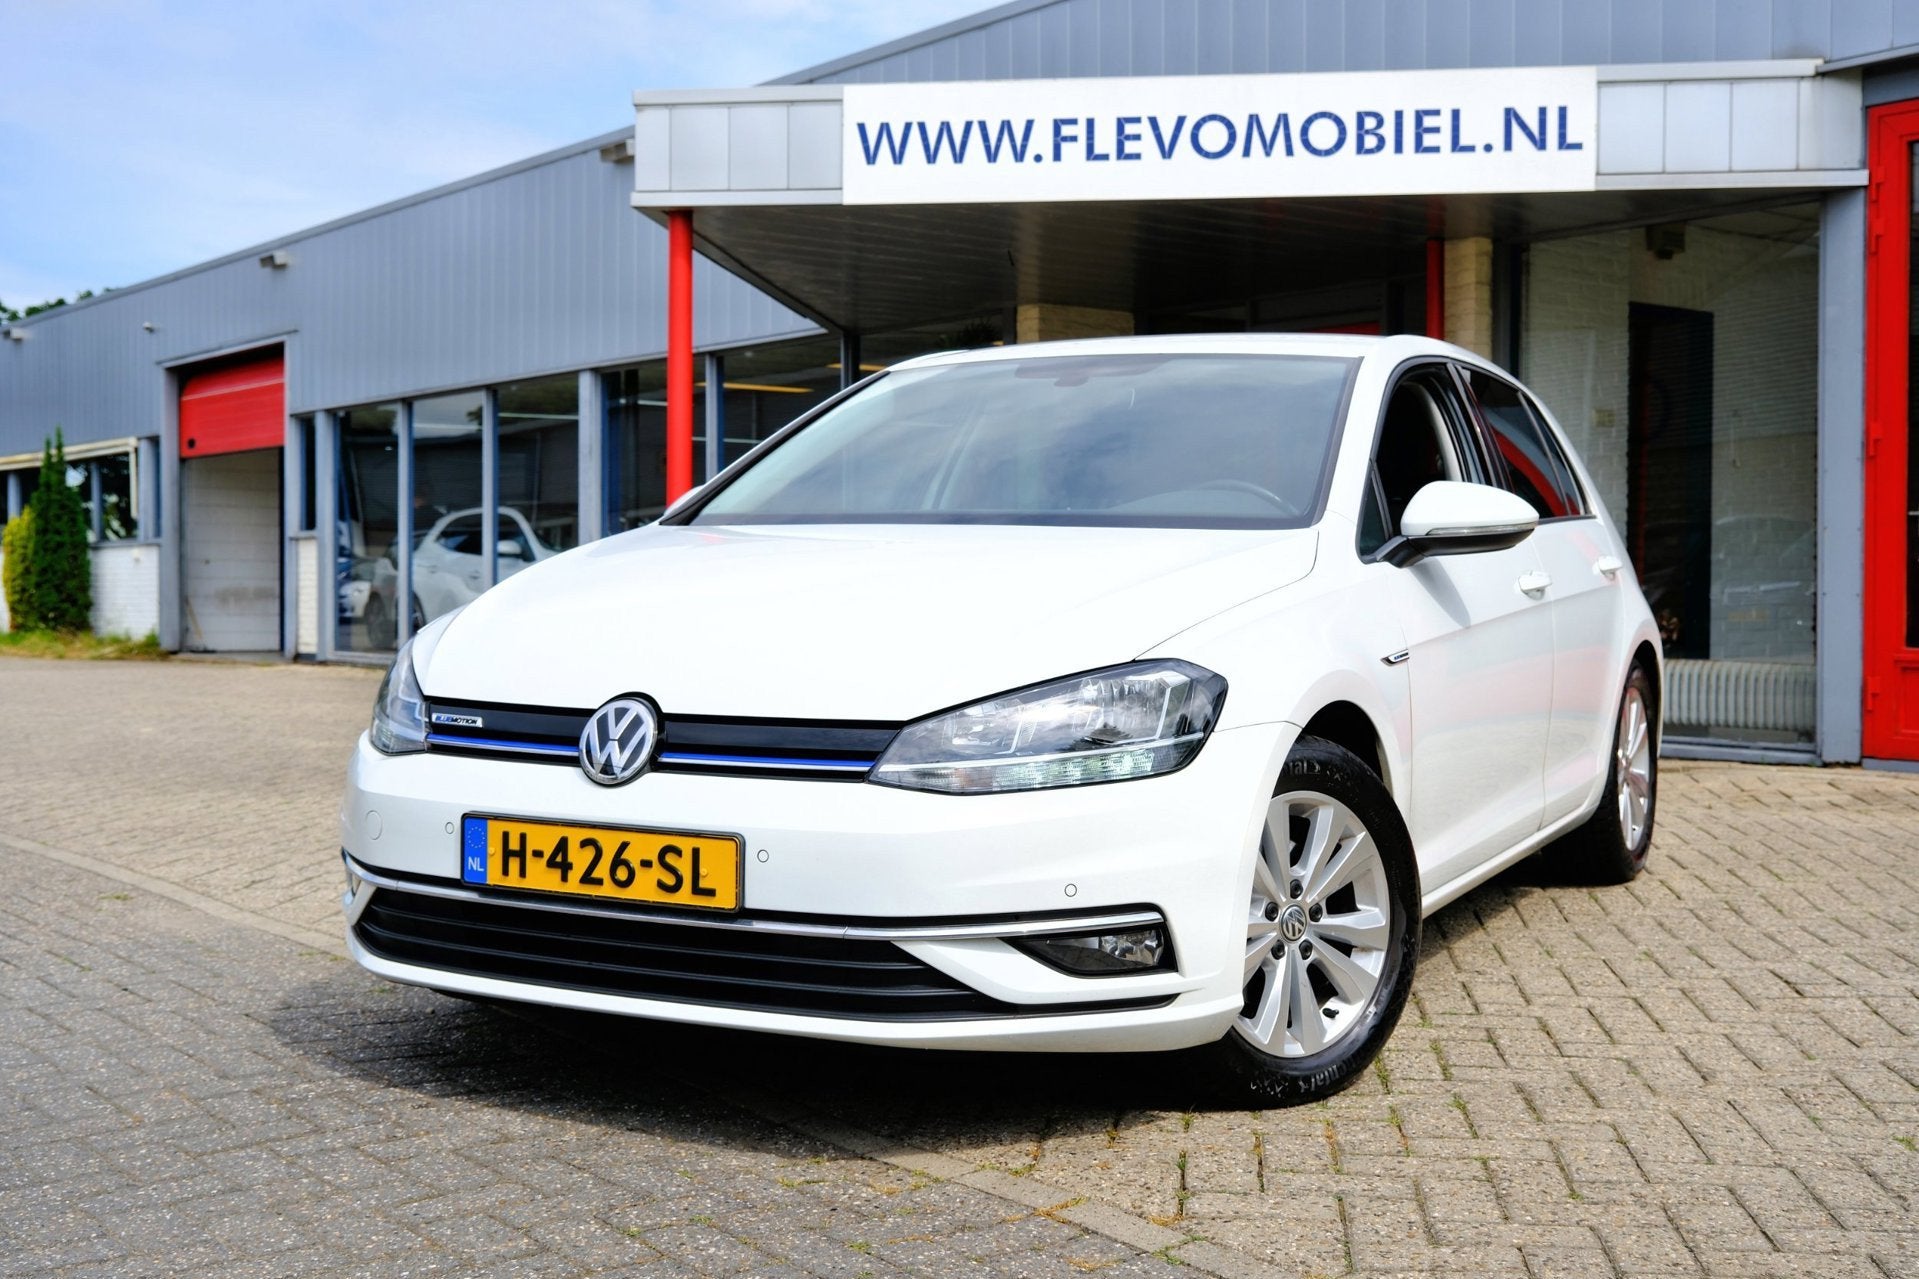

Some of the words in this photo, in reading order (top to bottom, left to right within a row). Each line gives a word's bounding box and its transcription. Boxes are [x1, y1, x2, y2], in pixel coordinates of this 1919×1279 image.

[856, 105, 1584, 166] WWW.FLEVOMOBIEL.NL
[467, 856, 485, 872] NL
[501, 830, 717, 898] H-426-SL
